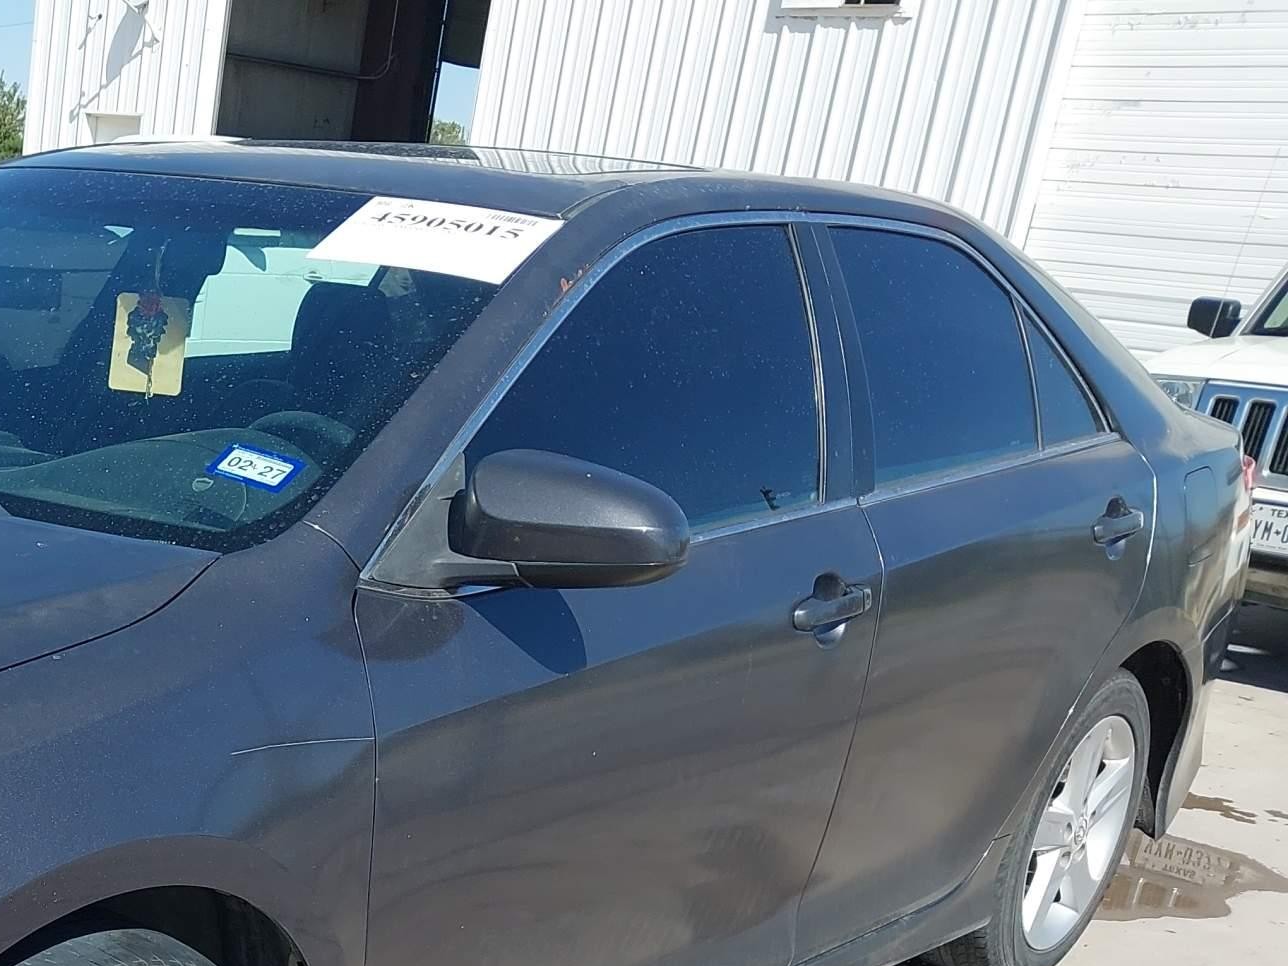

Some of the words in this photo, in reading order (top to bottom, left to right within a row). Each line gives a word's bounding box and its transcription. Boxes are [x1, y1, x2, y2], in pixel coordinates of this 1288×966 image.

[370, 210, 525, 240] 45905015
[227, 456, 253, 471] 02
[257, 465, 287, 480] 27
